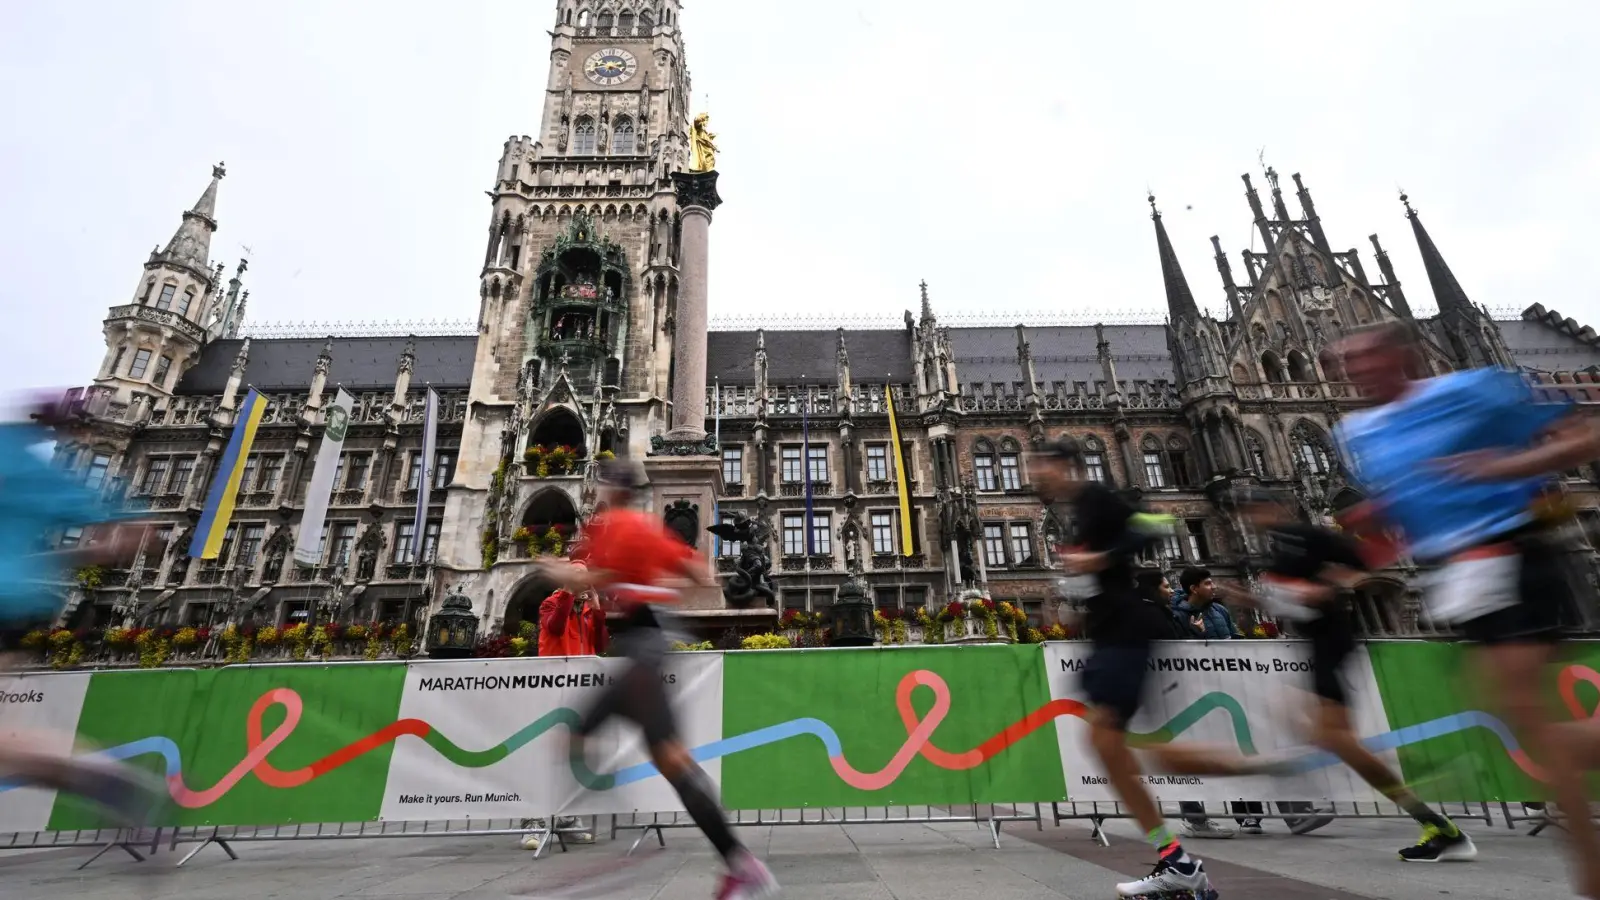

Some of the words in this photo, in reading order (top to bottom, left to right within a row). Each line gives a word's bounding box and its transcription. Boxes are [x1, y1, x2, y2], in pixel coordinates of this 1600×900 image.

[1157, 658, 1252, 671] MÜNCHEN
[1255, 662, 1269, 674] by
[1272, 658, 1317, 672] Brook
[419, 676, 510, 691] MARATHON
[1081, 775, 1108, 785] Make
[1148, 775, 1165, 785] Run
[1167, 775, 1204, 785] Munich.
[399, 794, 424, 804] Make
[426, 794, 433, 803] it
[434, 795, 462, 806] yours.
[465, 793, 482, 803] Run
[485, 792, 521, 802] Munich.
